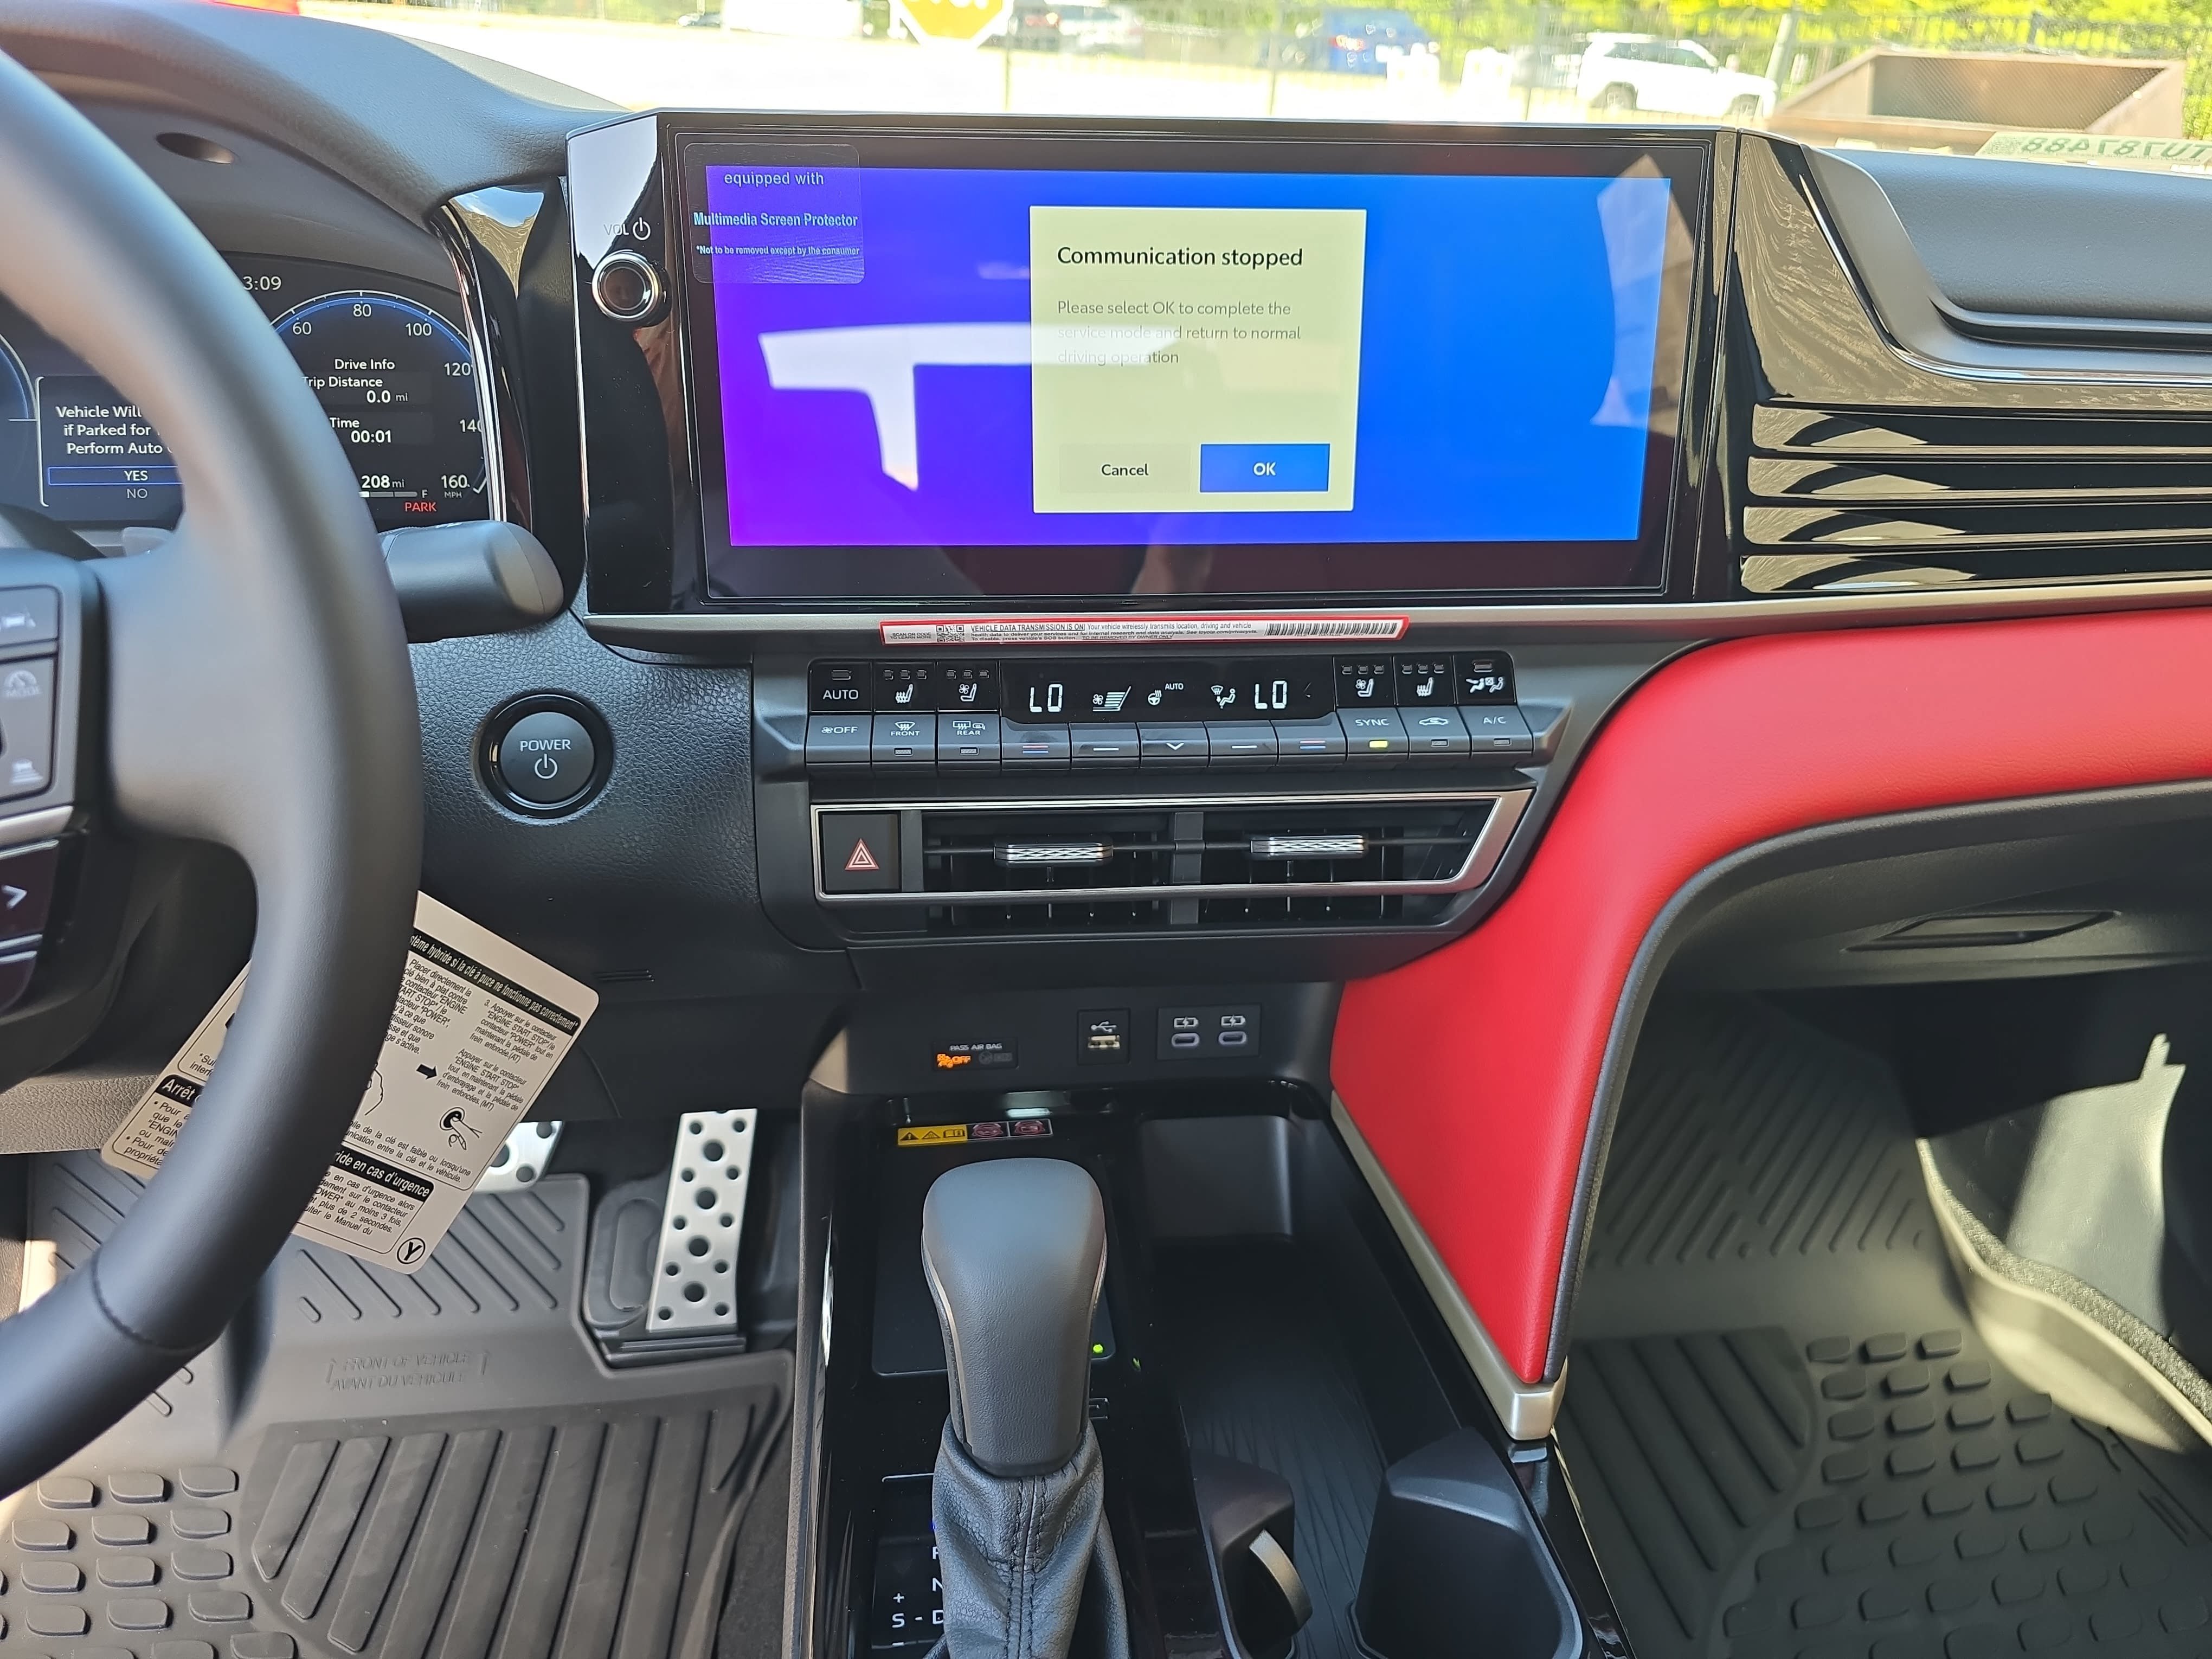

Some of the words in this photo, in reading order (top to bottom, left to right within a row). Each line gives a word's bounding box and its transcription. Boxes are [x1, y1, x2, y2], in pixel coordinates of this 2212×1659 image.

[724, 171, 790, 187] equipped
[795, 172, 824, 184] with
[693, 212, 757, 226] Multimedia
[761, 213, 800, 226] Screen
[803, 213, 858, 226] Protector
[603, 224, 629, 235] VOL
[736, 246, 768, 254] removed
[770, 247, 795, 256] except
[798, 247, 806, 256] by
[808, 246, 820, 254] the
[1057, 247, 1215, 266] Communication
[1221, 248, 1303, 269] stopped
[353, 304, 371, 317] 80
[1057, 301, 1104, 315] Please
[1107, 301, 1148, 314] select
[1153, 302, 1174, 314] OK
[1178, 304, 1193, 315] to
[1197, 303, 1264, 317] complete
[1268, 303, 1291, 315] the
[293, 321, 312, 335] 60
[406, 323, 432, 336] 100
[1058, 326, 1105, 339] service
[1110, 326, 1152, 339] mode
[1156, 326, 1182, 339] and
[1186, 328, 1229, 339] return
[1232, 328, 1247, 339] to
[1251, 327, 1301, 340] normal
[335, 359, 367, 370] Drive
[371, 359, 395, 370] Info
[1058, 351, 1106, 366] driving
[1111, 352, 1179, 366] operation
[444, 362, 471, 376] 120
[329, 376, 383, 387] Distance
[366, 390, 391, 403] 0.0
[396, 393, 408, 401] mi
[56, 406, 109, 417] Vehicle
[329, 417, 360, 428] Time
[63, 425, 74, 436] if
[77, 424, 126, 436] Parked
[130, 424, 151, 436] for
[351, 430, 391, 443] 00:01
[67, 442, 124, 454] Perform
[127, 443, 163, 454] Auto
[1101, 464, 1148, 476] Cancel
[1253, 462, 1276, 475] OK
[124, 471, 148, 481] YES
[361, 475, 390, 488] 208
[392, 479, 404, 487] mi
[441, 475, 467, 488] 160
[126, 488, 148, 499] NO
[404, 502, 437, 512] PARK
[822, 689, 859, 700] AUTO
[1030, 683, 1063, 713] LO
[1253, 680, 1288, 710] LO
[1355, 718, 1390, 726] SYNC
[1483, 715, 1507, 724] A/C
[833, 726, 858, 735] OFF
[520, 739, 572, 751] POWER
[409, 959, 431, 975] Placer
[429, 970, 465, 993] directement
[465, 986, 472, 997] la
[427, 944, 452, 964] hybride
[501, 984, 532, 1007] fonctionne
[415, 972, 429, 986] bien
[435, 985, 449, 995] plat
[448, 991, 468, 1005] contre
[481, 1019, 510, 1037] contacteur
[491, 1003, 515, 1019] Appuyer
[531, 1025, 557, 1041] contacteur
[413, 1025, 435, 1040] sonore
[474, 1026, 506, 1045] maintenant
[512, 1024, 531, 1038] START
[458, 1048, 483, 1064] Appuyer
[499, 1069, 527, 1085] contacteur
[953, 1056, 971, 1064] OFF
[442, 1072, 477, 1092] d'embrayage
[469, 1074, 499, 1091] maintenant
[480, 1069, 501, 1083] START
[162, 1079, 196, 1100] Arrêt
[159, 1102, 182, 1116] Pour
[152, 1112, 170, 1123] que
[139, 1129, 152, 1139] ou
[132, 1136, 155, 1150] Pour
[363, 1126, 373, 1134] de
[385, 1135, 397, 1144] clé
[397, 1140, 409, 1150] est
[410, 1145, 427, 1158] faible
[429, 1154, 439, 1162] ou
[440, 1158, 472, 1176] lorsqu'une
[377, 1143, 395, 1154] entre
[436, 1168, 461, 1183] véhicule.
[352, 1160, 367, 1172] en
[366, 1164, 384, 1179] cas
[384, 1172, 430, 1197] d'urgence
[333, 1174, 344, 1183] en
[346, 1179, 361, 1188] cas
[362, 1185, 396, 1203] d'urgence
[397, 1200, 415, 1211] alors
[345, 1200, 356, 1208] au
[358, 1205, 380, 1217] moins
[349, 1190, 362, 1199] sur
[372, 1199, 409, 1218] contacteur
[334, 1216, 361, 1231] Manuel
[362, 1226, 373, 1236] du
[337, 1207, 348, 1215] de
[359, 1216, 393, 1233] secondes.
[892, 1613, 905, 1628] S
